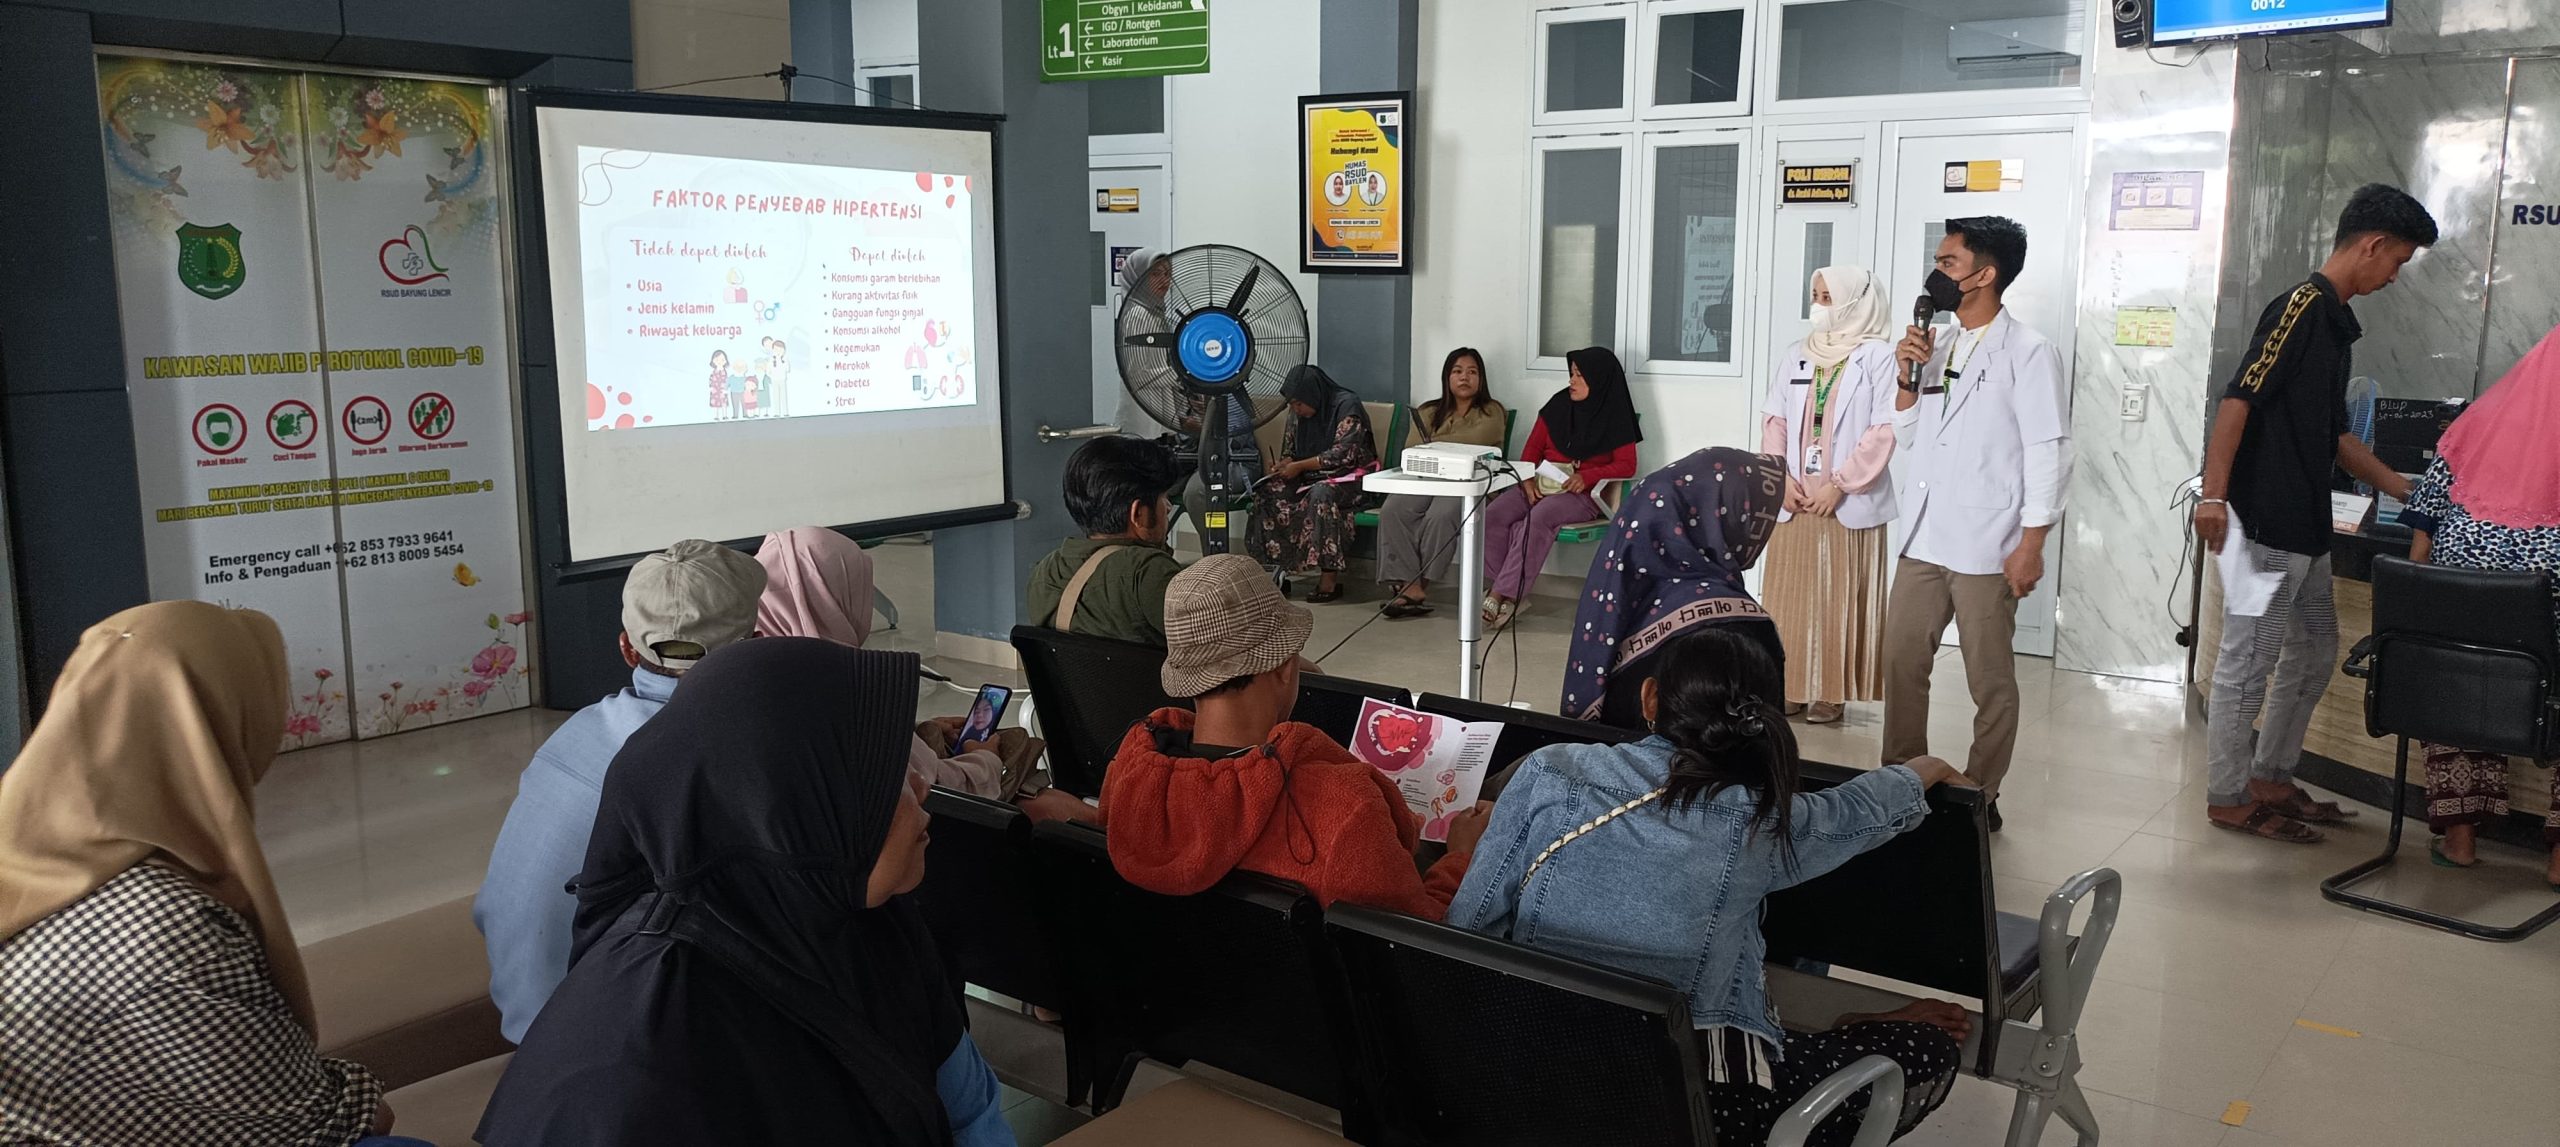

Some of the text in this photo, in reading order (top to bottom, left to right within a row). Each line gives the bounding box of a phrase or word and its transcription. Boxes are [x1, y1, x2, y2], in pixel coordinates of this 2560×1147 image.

[1102, 5, 1129, 17] Obgyn
[1138, 0, 1182, 12] Kebidanan
[2251, 0, 2285, 11] 0012
[1102, 19, 1161, 32] IGD / Rontgen
[1102, 35, 1158, 48] Laboratorium
[1102, 56, 1123, 66] Kasir
[1345, 160, 1367, 170] HUMAS
[1345, 168, 1367, 180] RSUD
[1787, 168, 1812, 182] POLI
[653, 188, 922, 220] FAKTOR PENYEBAB HIPERTENSI
[630, 240, 674, 256] Tidak
[680, 242, 719, 264] dapat
[850, 246, 885, 266] Dapat
[638, 279, 662, 292] Usia
[832, 273, 940, 286] Konsumsi garam berlebihan
[381, 290, 400, 298] RSUD
[401, 290, 427, 298] BAYUNG
[832, 290, 918, 303] Kurang aktivitas fisik
[638, 302, 715, 314] Jenis kelamin
[832, 308, 924, 321] Gangguan fungsi ginjal
[640, 324, 742, 341] Riwayat keluarga
[833, 325, 900, 336] Konsumsi alkohol
[834, 344, 880, 356] Kegemukan
[144, 354, 246, 380] KAWASAN
[247, 352, 307, 375] WAJIB
[407, 346, 484, 368] COVID-19
[834, 361, 870, 370] Merokok
[834, 378, 870, 388] Diabetes
[835, 396, 856, 407] Stres
[197, 458, 218, 467] Pakai
[273, 452, 316, 462] Cuci Tangan
[208, 484, 260, 501] MAXIMUM
[262, 480, 310, 496] CAPACITY
[156, 508, 186, 522] MARI
[187, 503, 238, 520] BERSAMA
[238, 500, 272, 514] TURUT
[273, 496, 304, 512] SERTA
[210, 550, 290, 568] Emergency
[295, 544, 320, 558] call
[360, 538, 384, 552] 853
[388, 534, 420, 549] 7933
[424, 530, 453, 544] 9641
[205, 544, 464, 584] Info & Pengaduan +62 813 8009 5454
